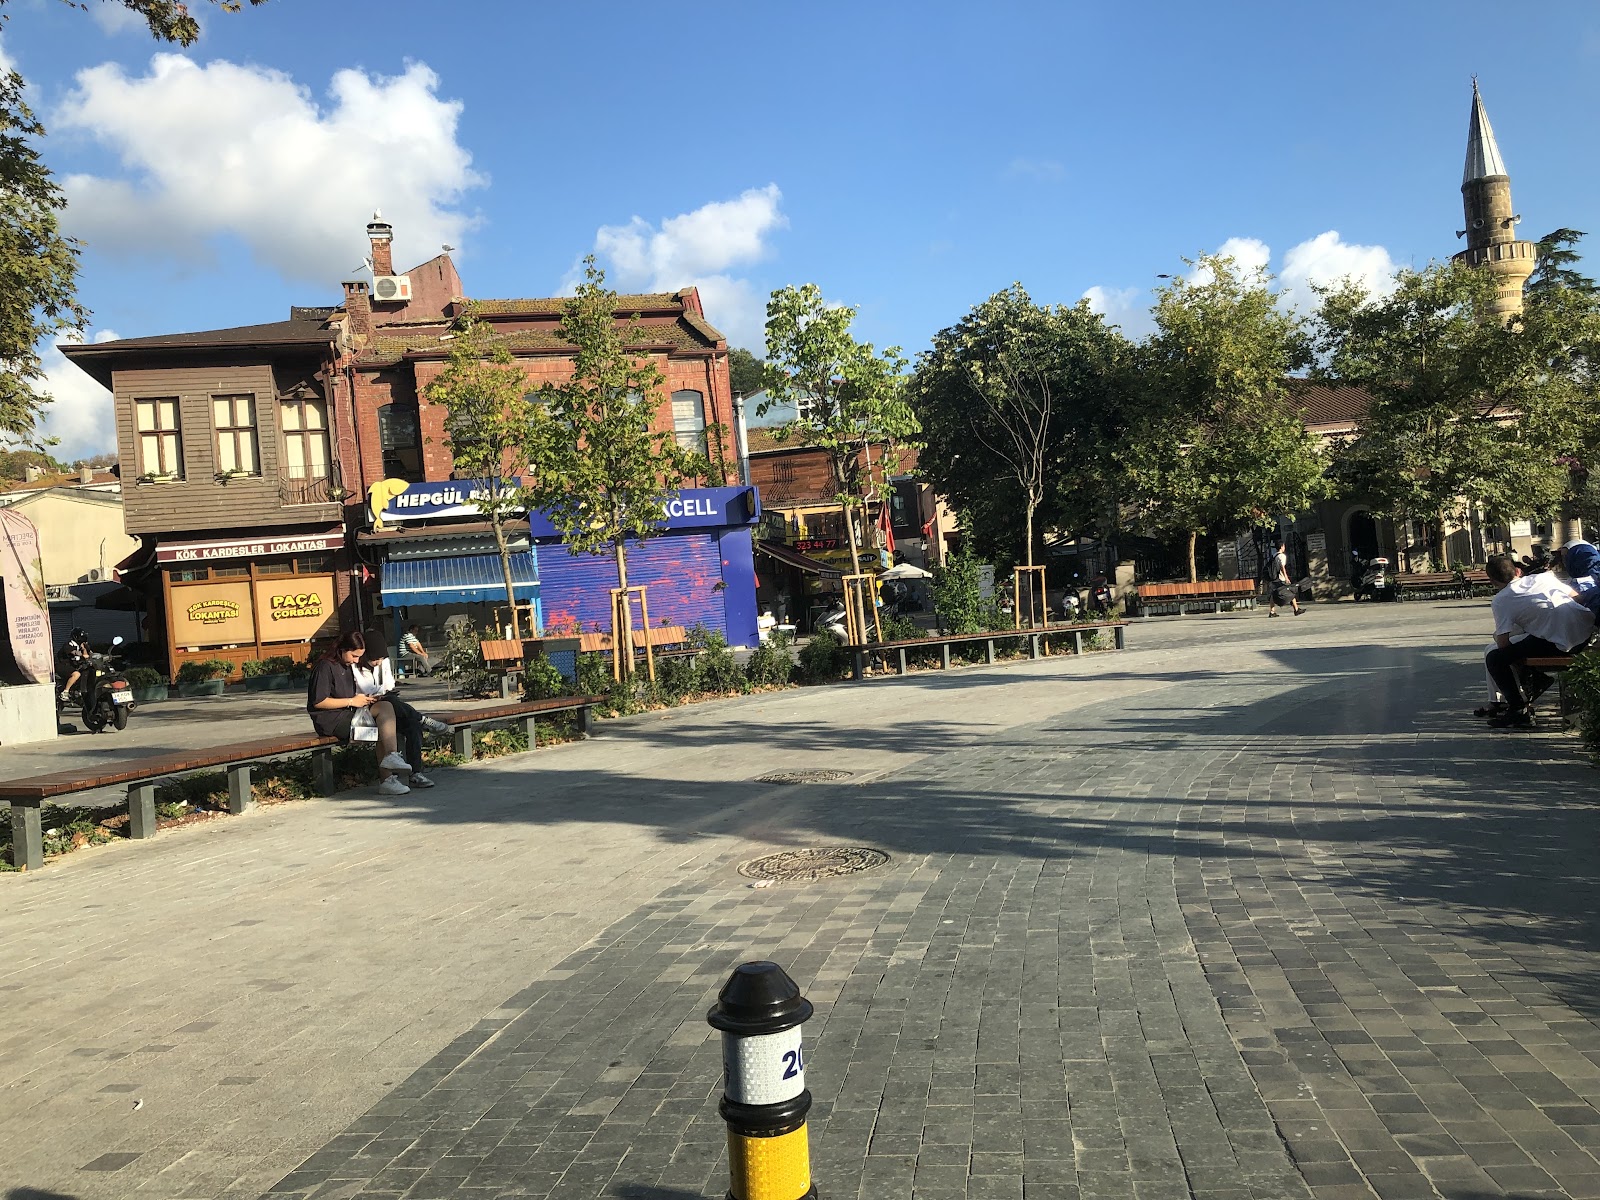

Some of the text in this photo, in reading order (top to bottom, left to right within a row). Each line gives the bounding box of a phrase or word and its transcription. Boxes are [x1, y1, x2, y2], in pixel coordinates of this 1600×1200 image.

[397, 487, 517, 508] HEPGÜL BAIK
[175, 549, 197, 560] KÖK
[270, 540, 327, 553] LOKANTASI
[796, 539, 836, 550] 323 44 77
[271, 593, 322, 609] PAÇA
[189, 610, 239, 621] LOKANTASI
[272, 607, 323, 621] ÇORBASI
